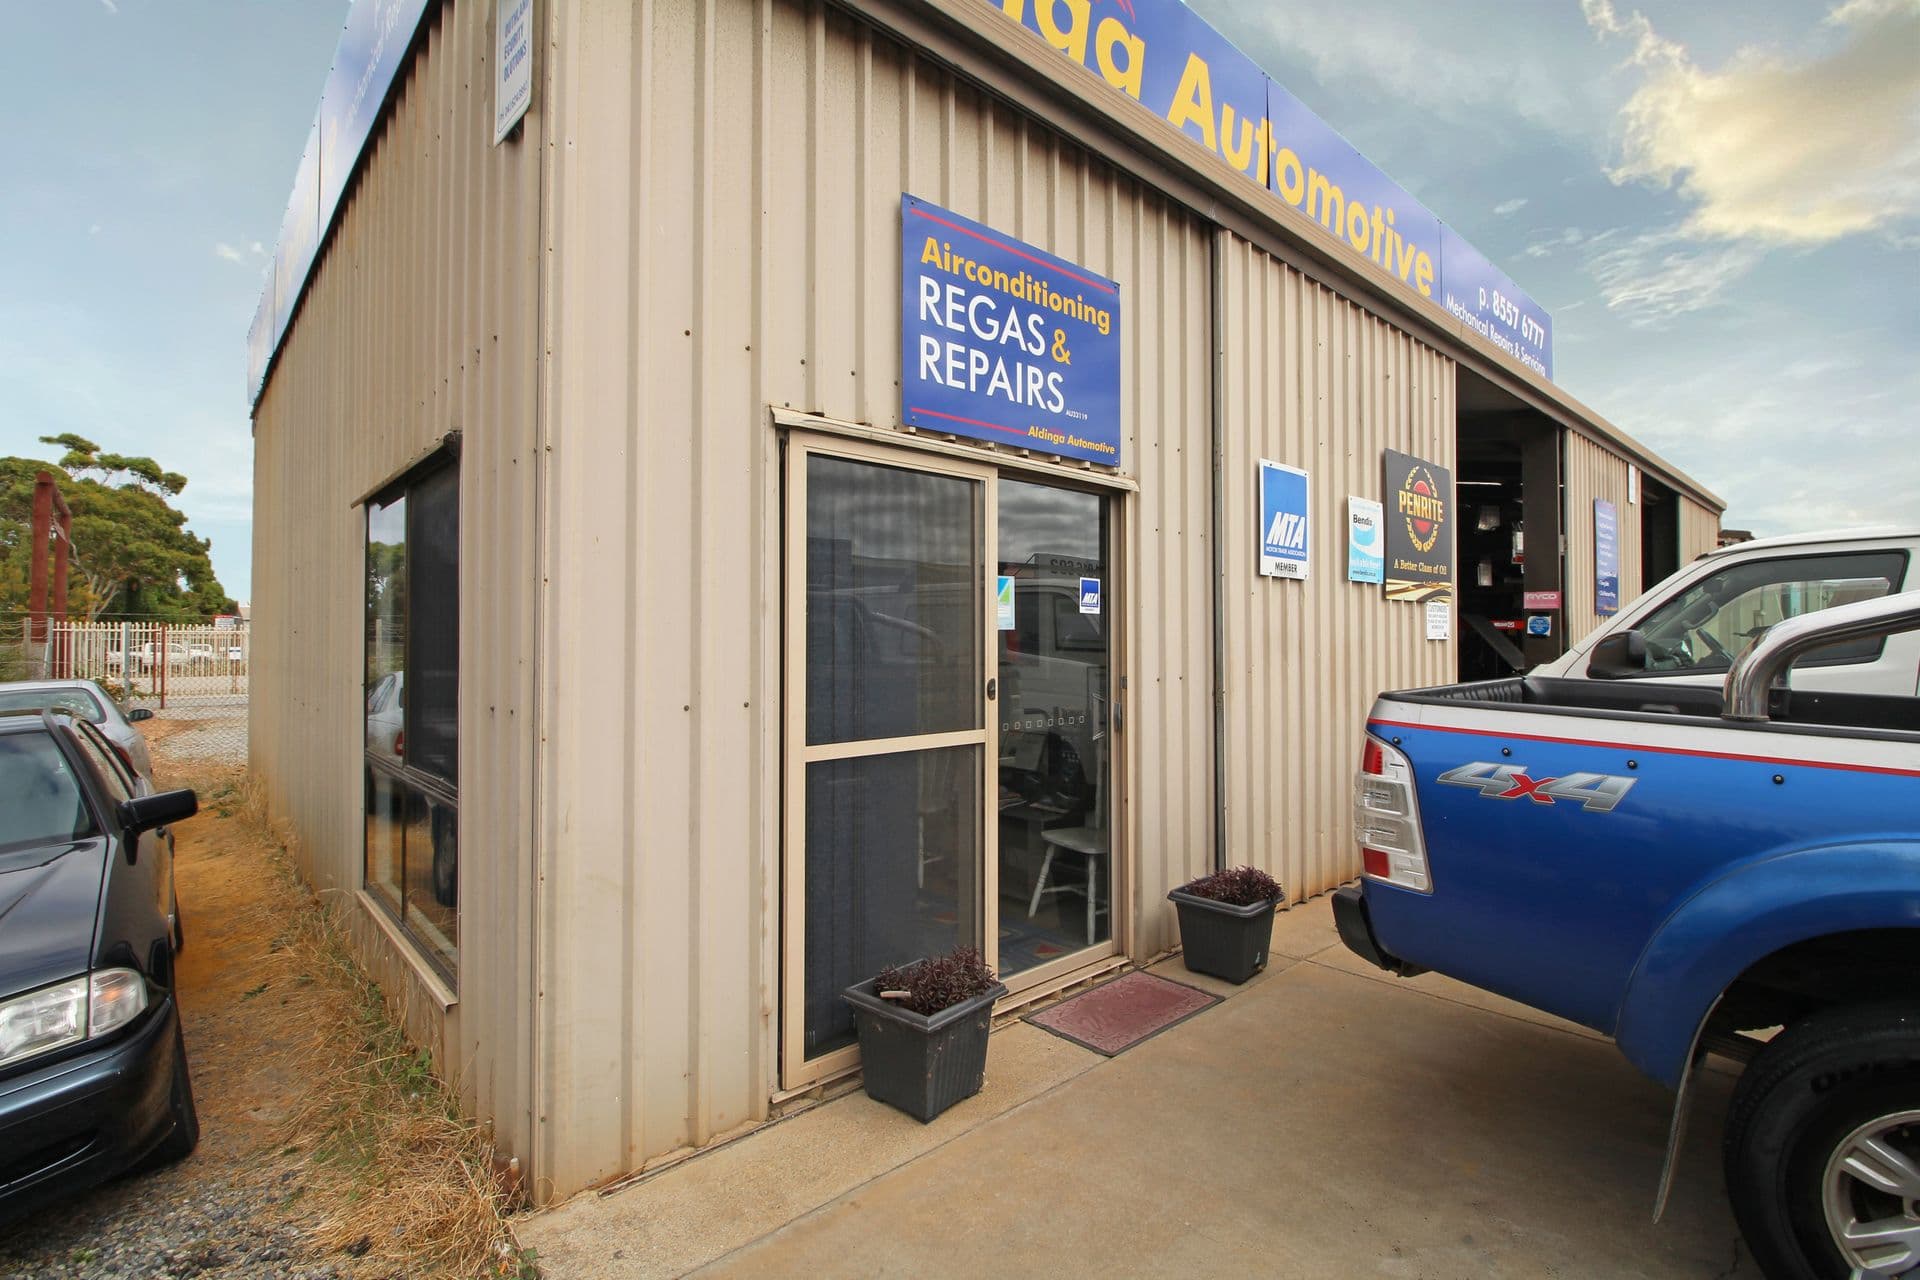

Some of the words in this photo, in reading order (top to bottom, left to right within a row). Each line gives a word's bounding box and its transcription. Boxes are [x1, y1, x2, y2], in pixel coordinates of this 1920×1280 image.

[1166, 52, 1434, 299] Automotive
[920, 236, 1111, 336] Airconditioning
[919, 274, 1046, 356] REGAS
[1051, 328, 1072, 365] &
[1446, 292, 1489, 337] Mechanical
[1489, 323, 1514, 356] Repairs
[1514, 342, 1520, 359] &
[1520, 346, 1546, 377] Servicing
[1492, 290, 1519, 330] 8557
[1521, 314, 1545, 350] 6777
[919, 334, 1065, 414] REPAIRS
[1027, 424, 1066, 445] Aldinga
[1067, 434, 1115, 455] Automotive
[1266, 511, 1306, 549] MTA
[1398, 489, 1444, 523] PENRITE
[1274, 561, 1298, 573] MEMBER
[1394, 558, 1399, 569] A
[1400, 560, 1418, 571] Better
[1418, 562, 1433, 573] Class
[1433, 564, 1439, 574] of
[1439, 565, 1447, 575] Oil
[1081, 592, 1098, 604] MTA
